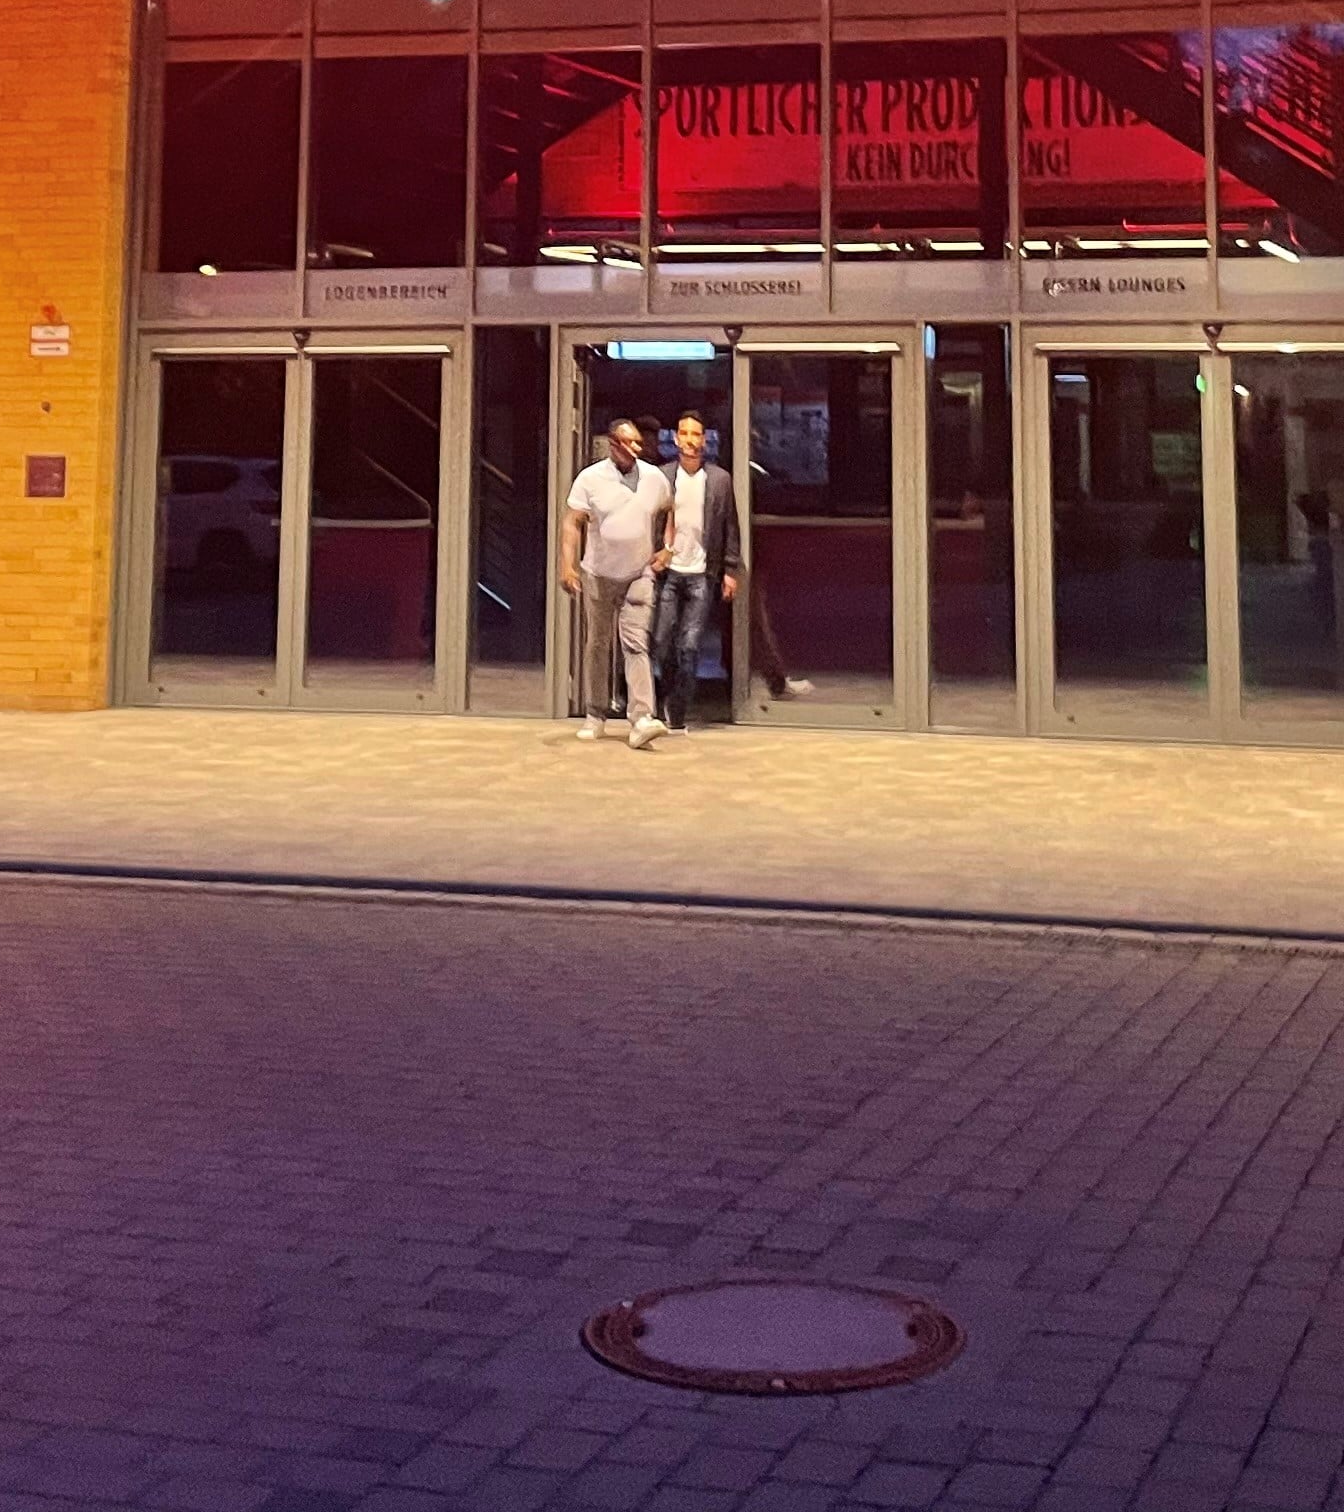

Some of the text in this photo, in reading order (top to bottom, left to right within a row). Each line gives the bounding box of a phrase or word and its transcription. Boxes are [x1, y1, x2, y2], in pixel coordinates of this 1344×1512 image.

[846, 138, 1071, 181] KEIN DURCNG!
[324, 284, 448, 301] LOGENBEREICH
[670, 279, 802, 296] ZUR SCHLOSSEREI
[1108, 276, 1186, 294] LOUNGES
